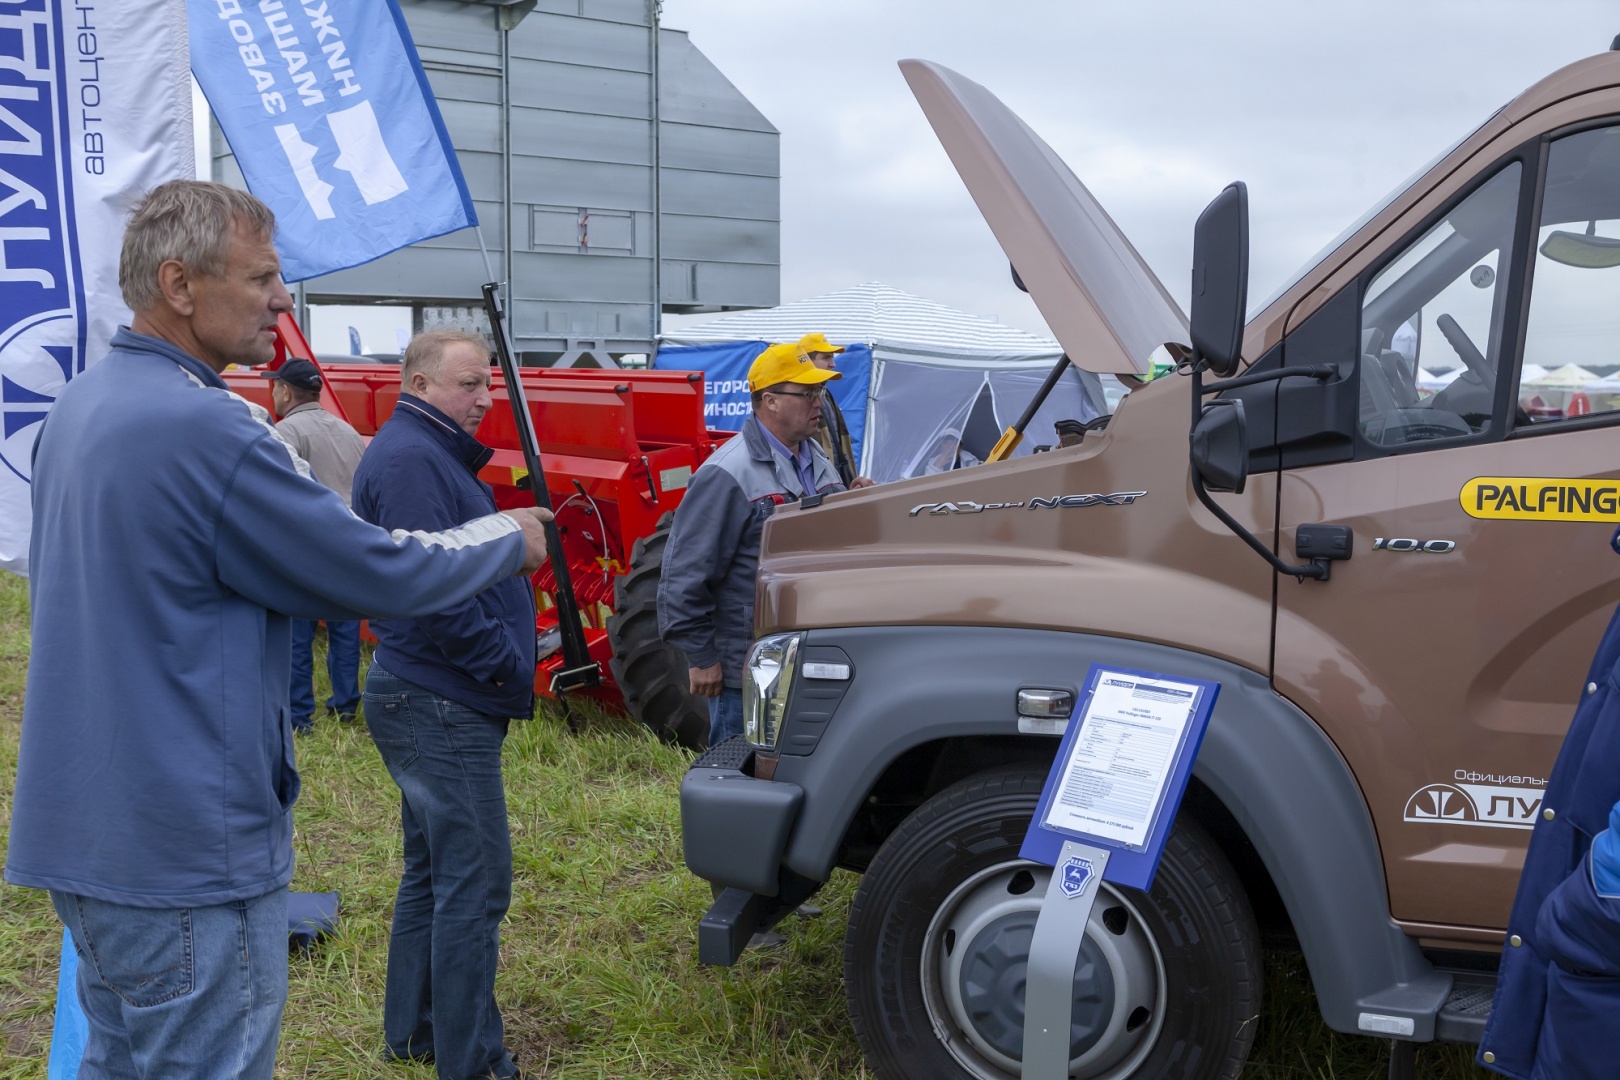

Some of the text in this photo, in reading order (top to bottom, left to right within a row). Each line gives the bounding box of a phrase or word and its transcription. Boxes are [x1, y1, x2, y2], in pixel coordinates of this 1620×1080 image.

[75, 0, 104, 175] автоцен
[0, 0, 55, 289] ЛУИД
[1027, 490, 1148, 510] NEXT
[1476, 484, 1620, 514] PALFING
[1372, 537, 1456, 553] 10.0
[1487, 795, 1542, 819] ЛУ
